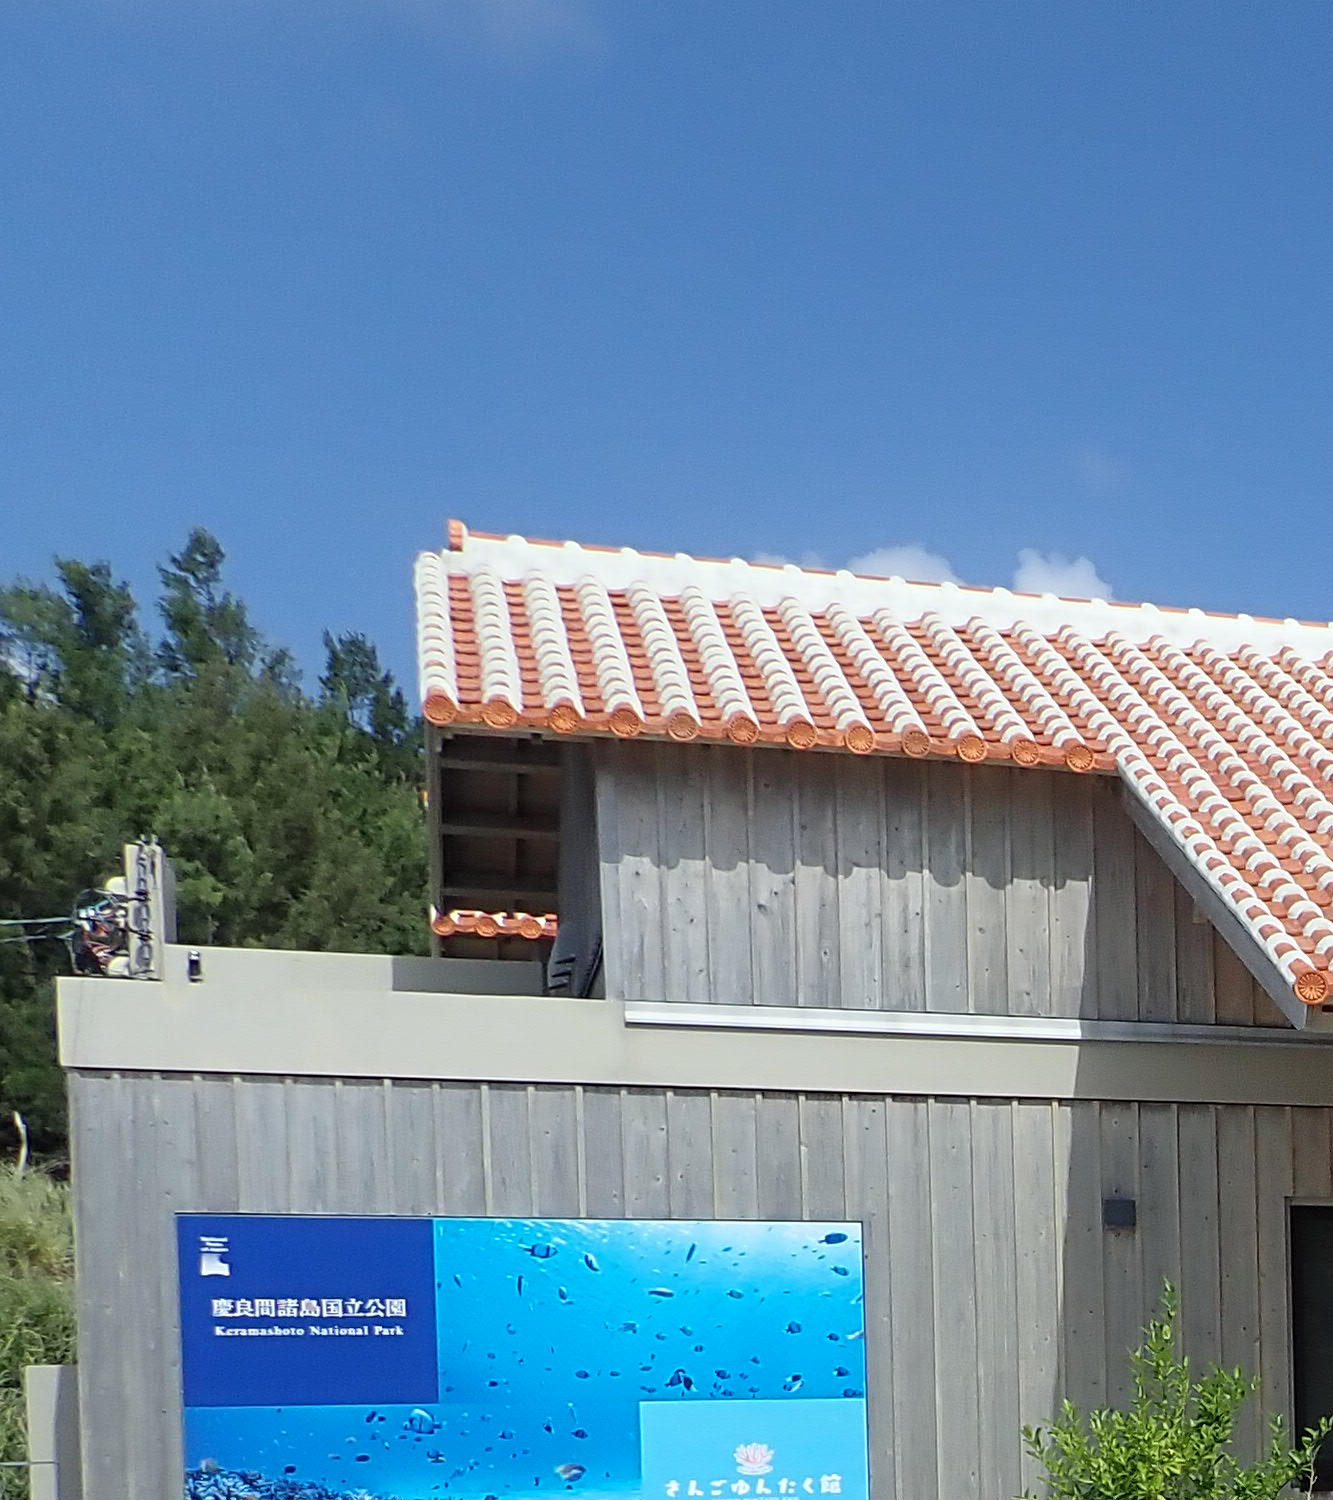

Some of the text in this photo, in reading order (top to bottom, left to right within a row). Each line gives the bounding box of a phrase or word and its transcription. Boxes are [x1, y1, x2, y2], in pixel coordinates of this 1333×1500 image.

[212, 1298, 407, 1317] 慶良間諸島国立公園
[215, 1325, 404, 1336] Keramashoto National Park
[664, 1474, 843, 1497] さんごゆんたく館
